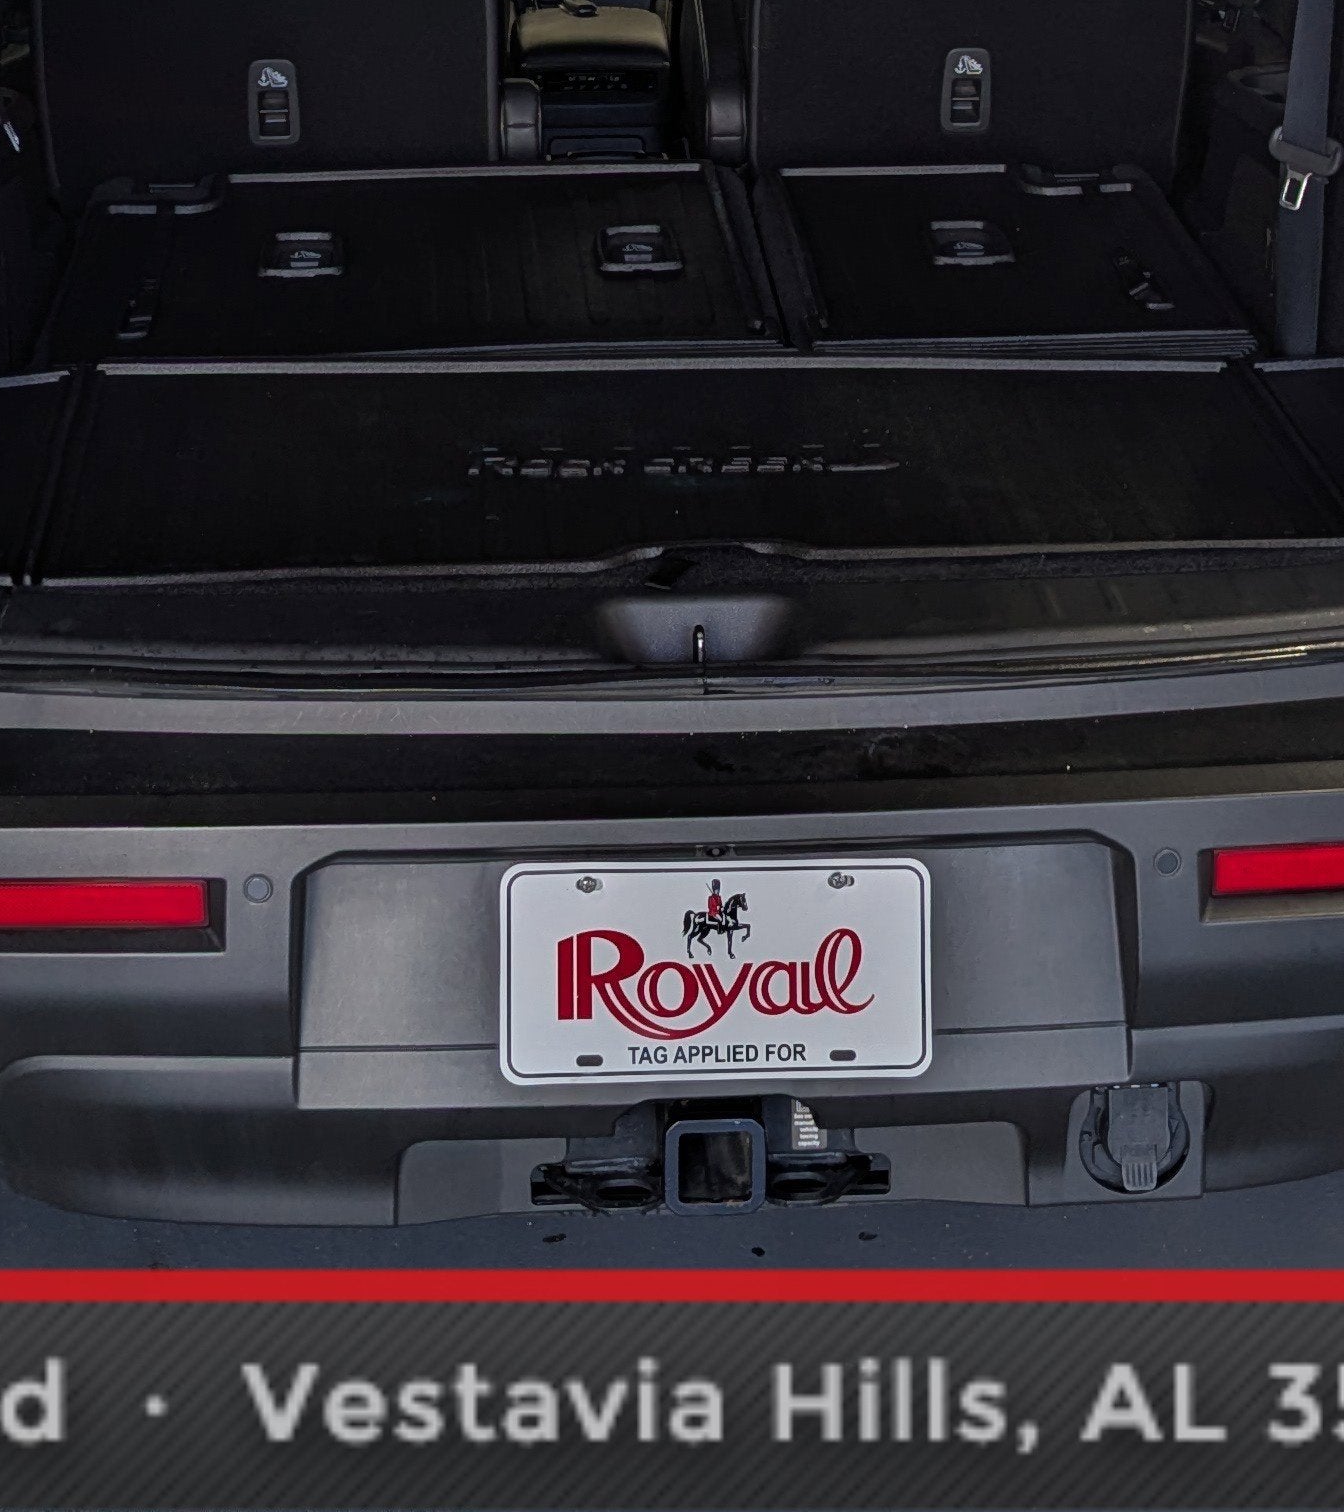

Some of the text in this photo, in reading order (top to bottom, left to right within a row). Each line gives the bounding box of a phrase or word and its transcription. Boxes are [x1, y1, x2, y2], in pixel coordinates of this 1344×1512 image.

[557, 928, 875, 1039] Royal
[628, 1043, 806, 1064] TAG APPLIED FOR
